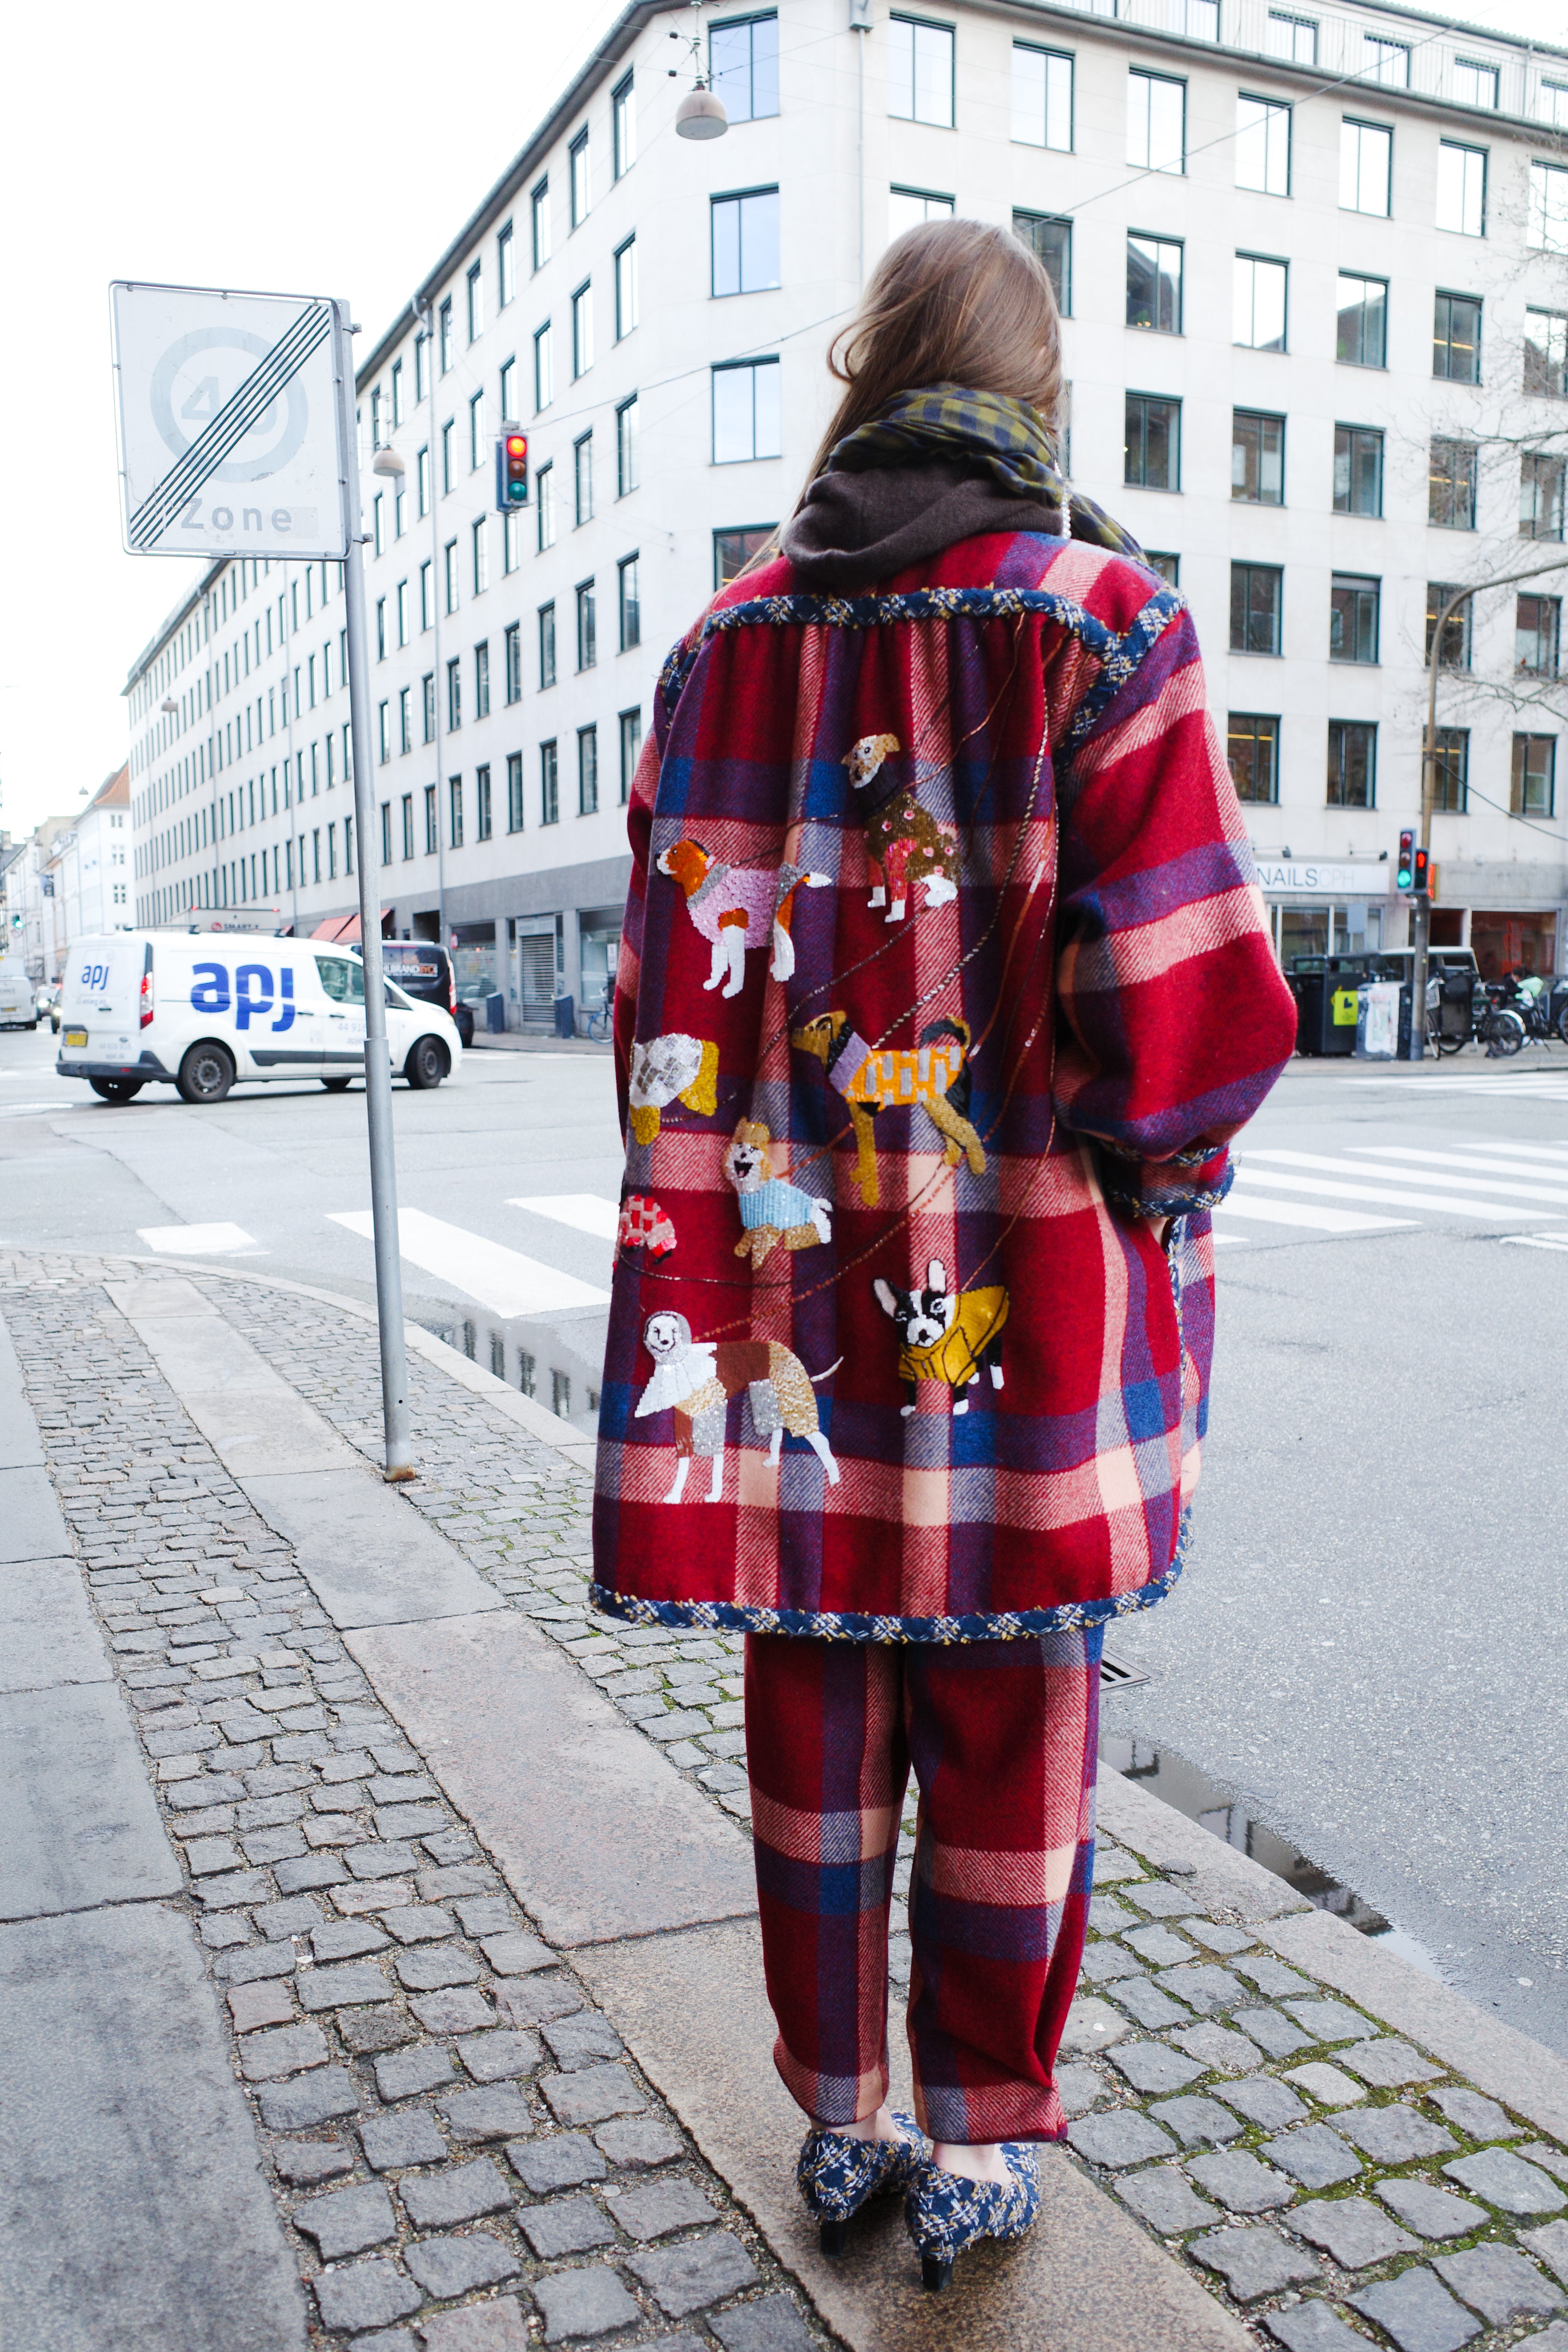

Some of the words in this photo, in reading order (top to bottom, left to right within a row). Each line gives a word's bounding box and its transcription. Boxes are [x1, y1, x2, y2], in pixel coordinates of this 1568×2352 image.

[181, 376, 278, 435] 40
[180, 498, 292, 532] Zone
[1257, 868, 1317, 887] NAILS
[82, 965, 109, 990] apj
[191, 963, 295, 1032] apj
